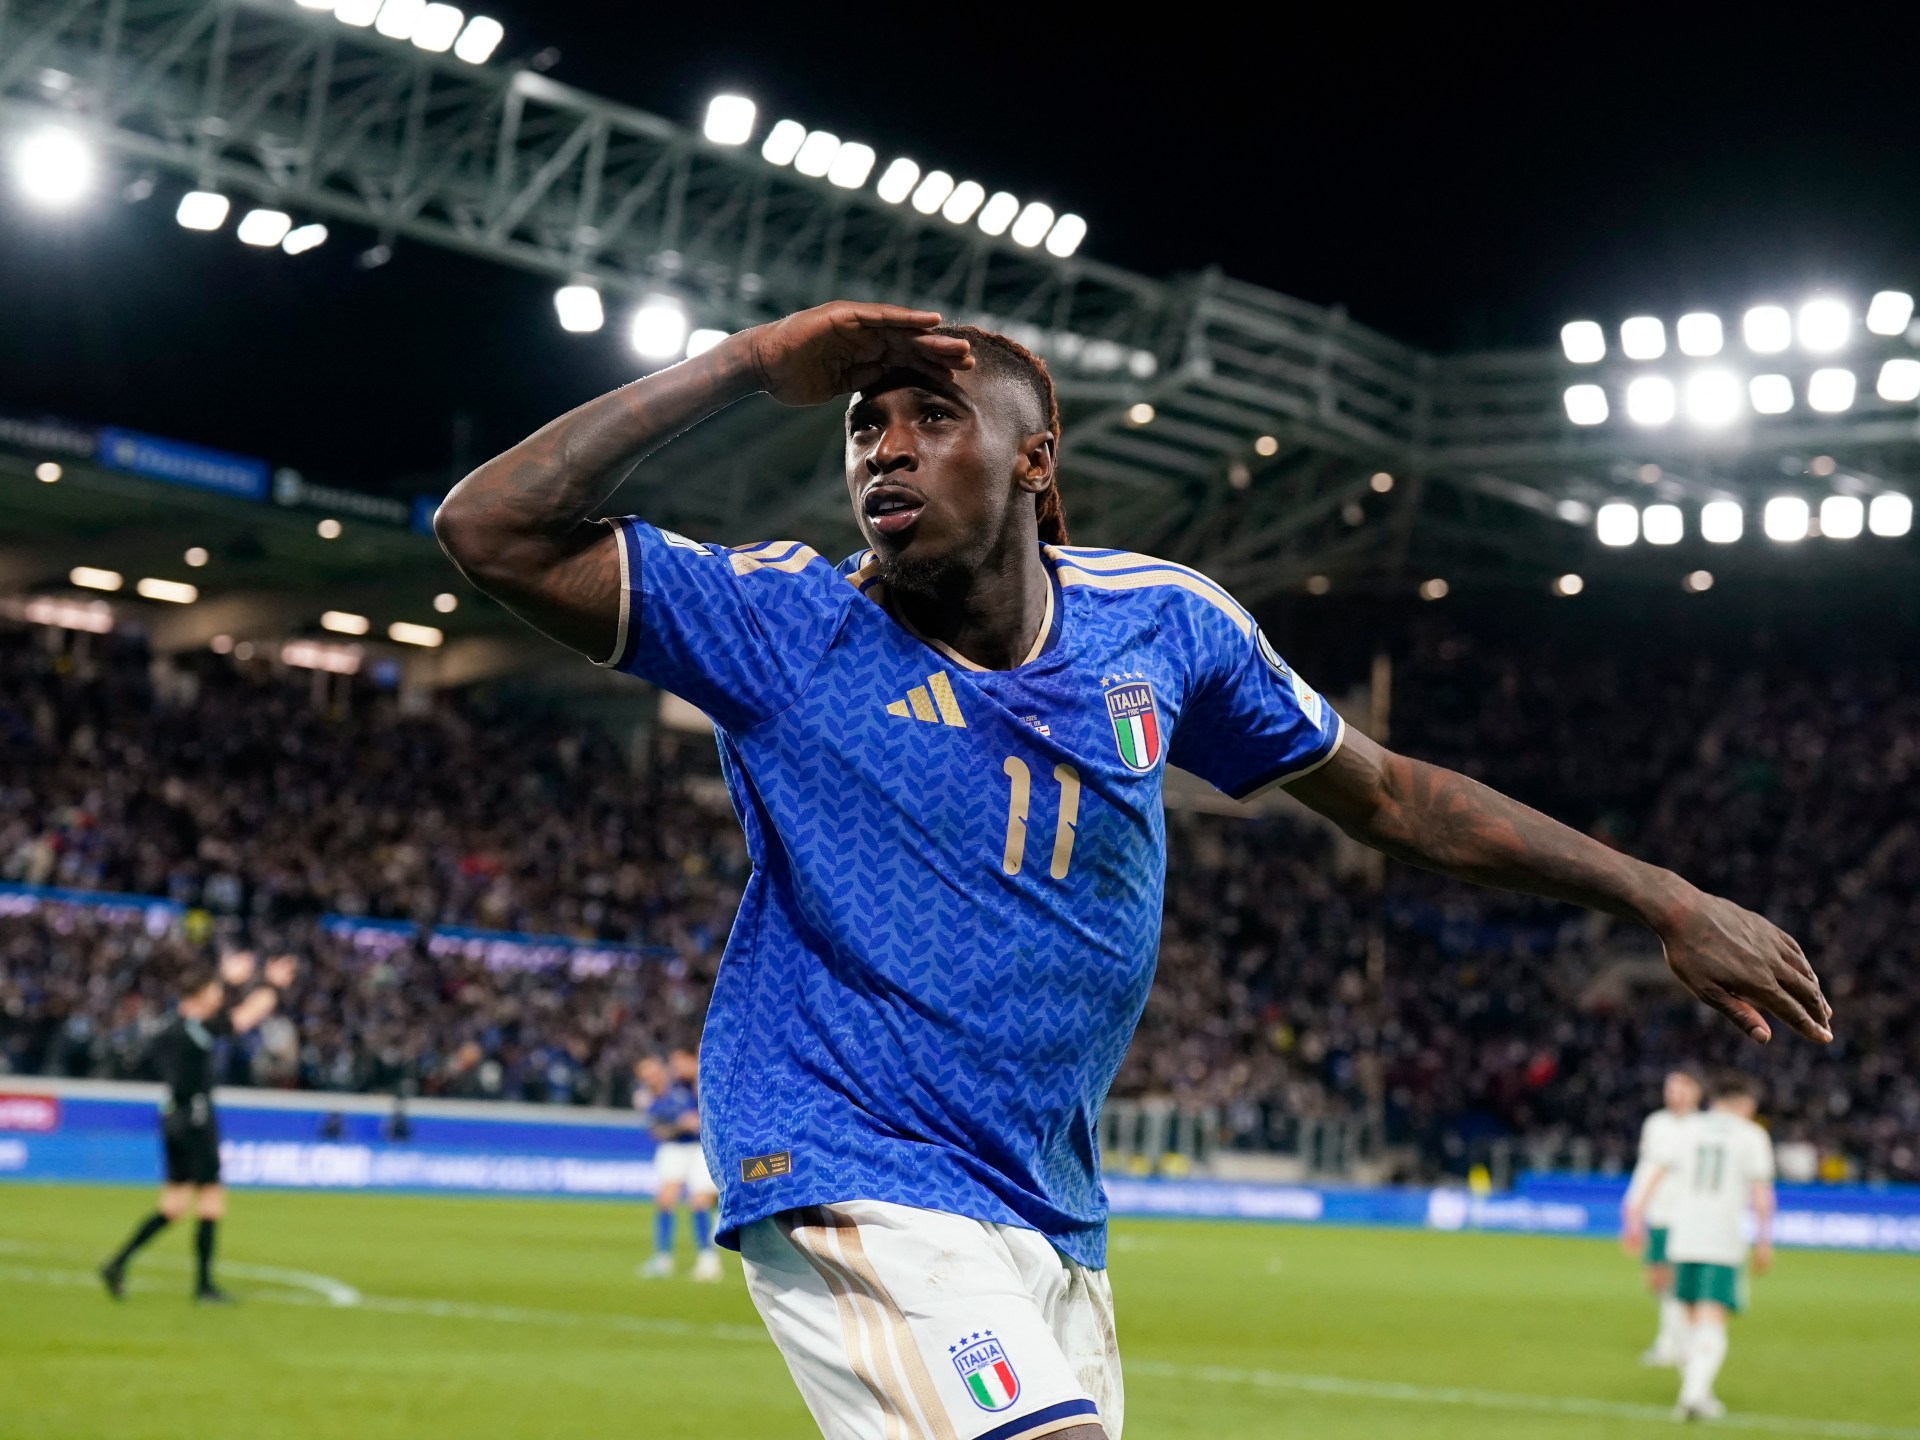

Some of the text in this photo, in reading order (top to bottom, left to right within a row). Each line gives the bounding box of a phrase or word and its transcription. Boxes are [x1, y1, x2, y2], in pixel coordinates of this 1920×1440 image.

[1109, 688, 1151, 712] ITALIA
[1003, 755, 1080, 880] 11
[1695, 1144, 1723, 1192] 11
[957, 1344, 1000, 1371] ITALIA
